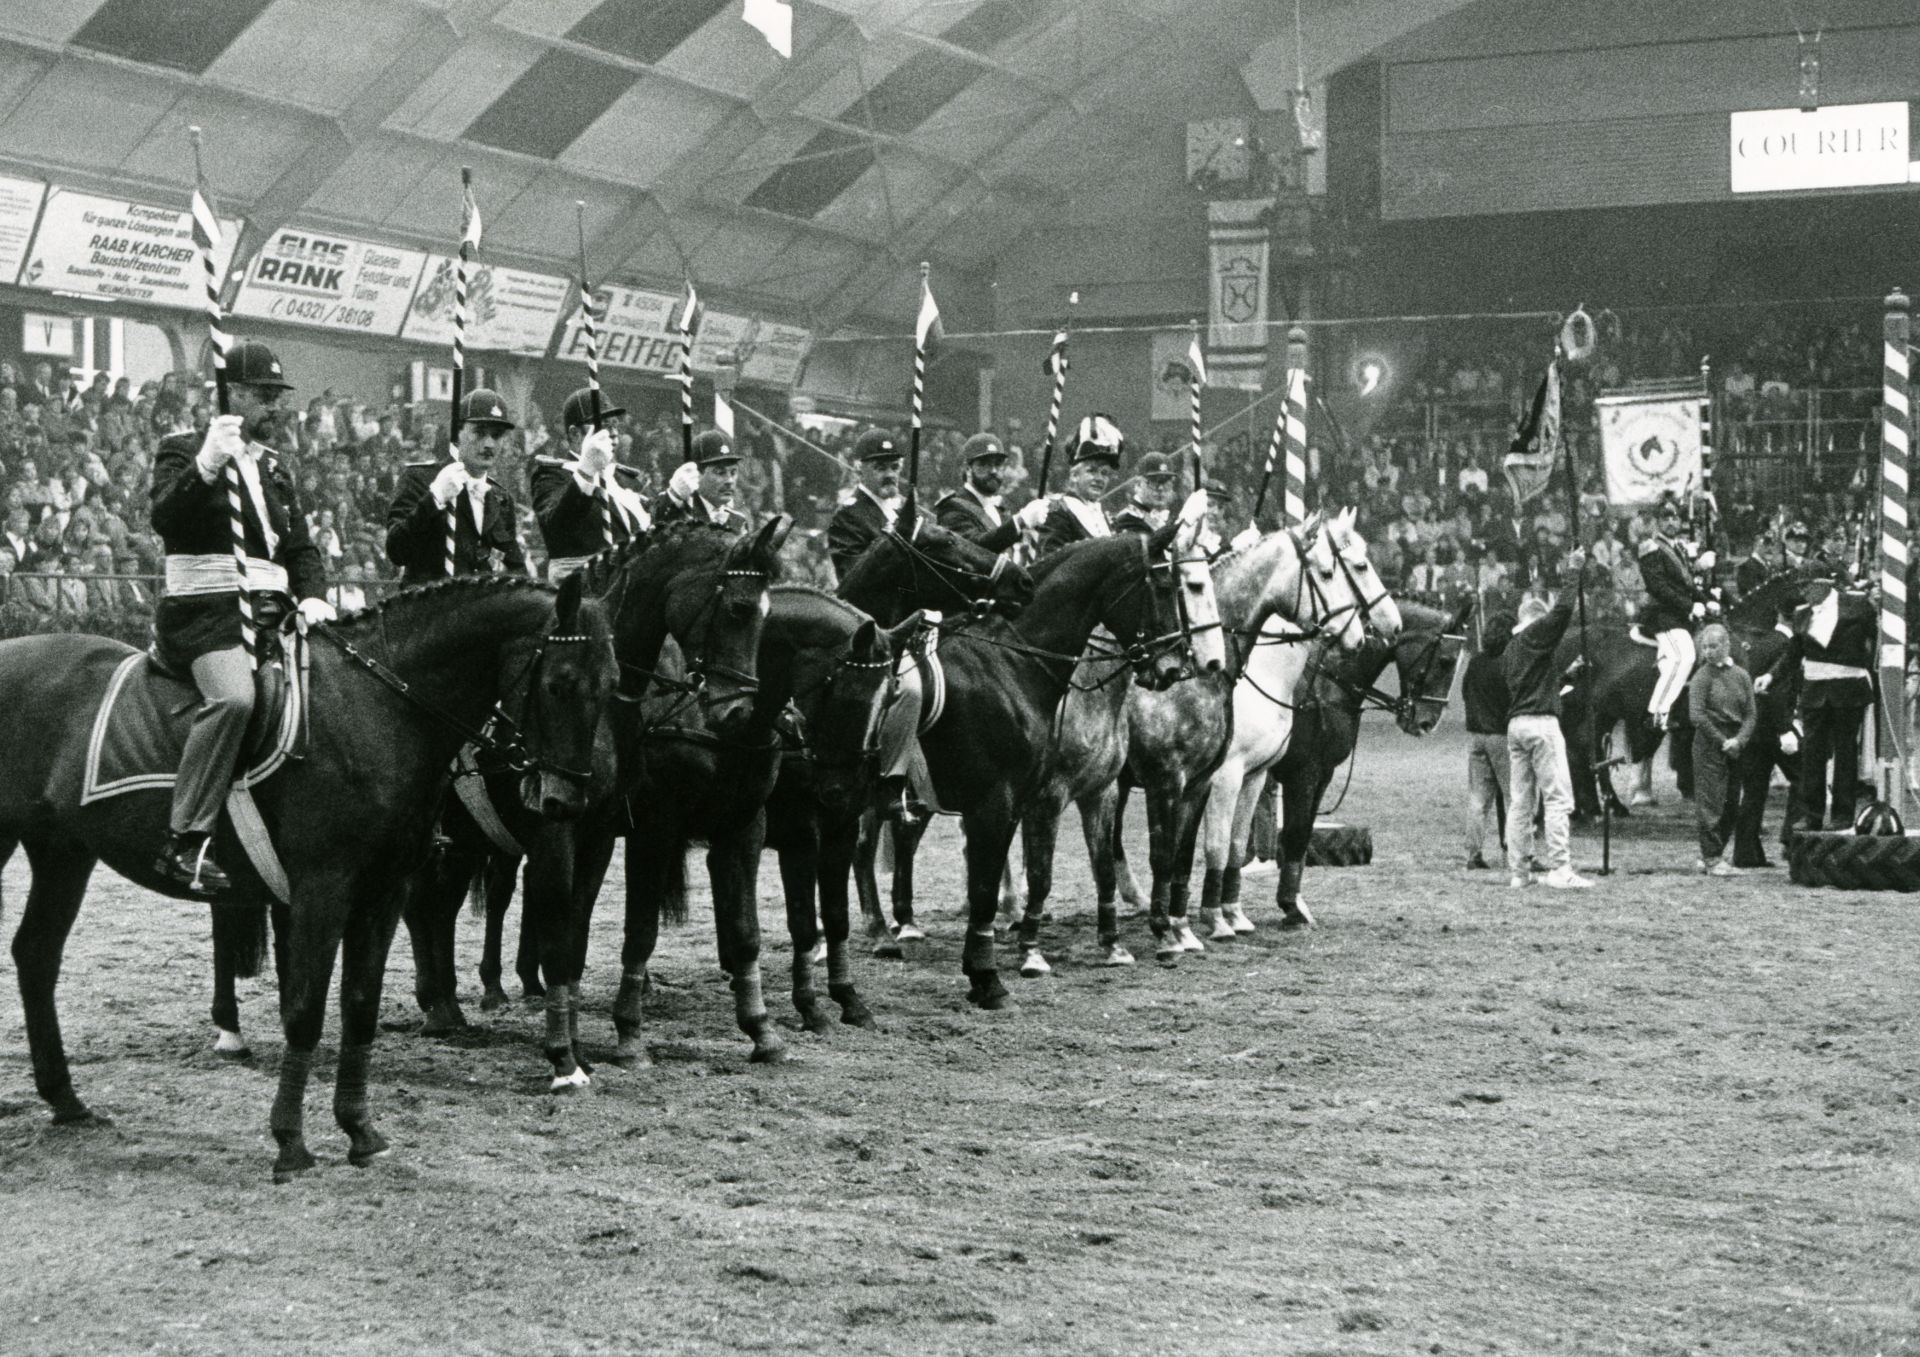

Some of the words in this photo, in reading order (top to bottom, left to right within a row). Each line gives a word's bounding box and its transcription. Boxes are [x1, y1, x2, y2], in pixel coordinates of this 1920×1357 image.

[82, 211, 97, 223] für
[97, 215, 127, 229] ganze
[128, 220, 174, 237] Lösungen
[127, 203, 181, 223] Kompetent
[89, 234, 128, 251] RAAB
[130, 241, 195, 263] KARCHER
[275, 234, 348, 265] GLAS
[90, 251, 182, 276] Baustoffzentrum
[258, 257, 346, 291] RANK
[43, 320, 53, 347] V
